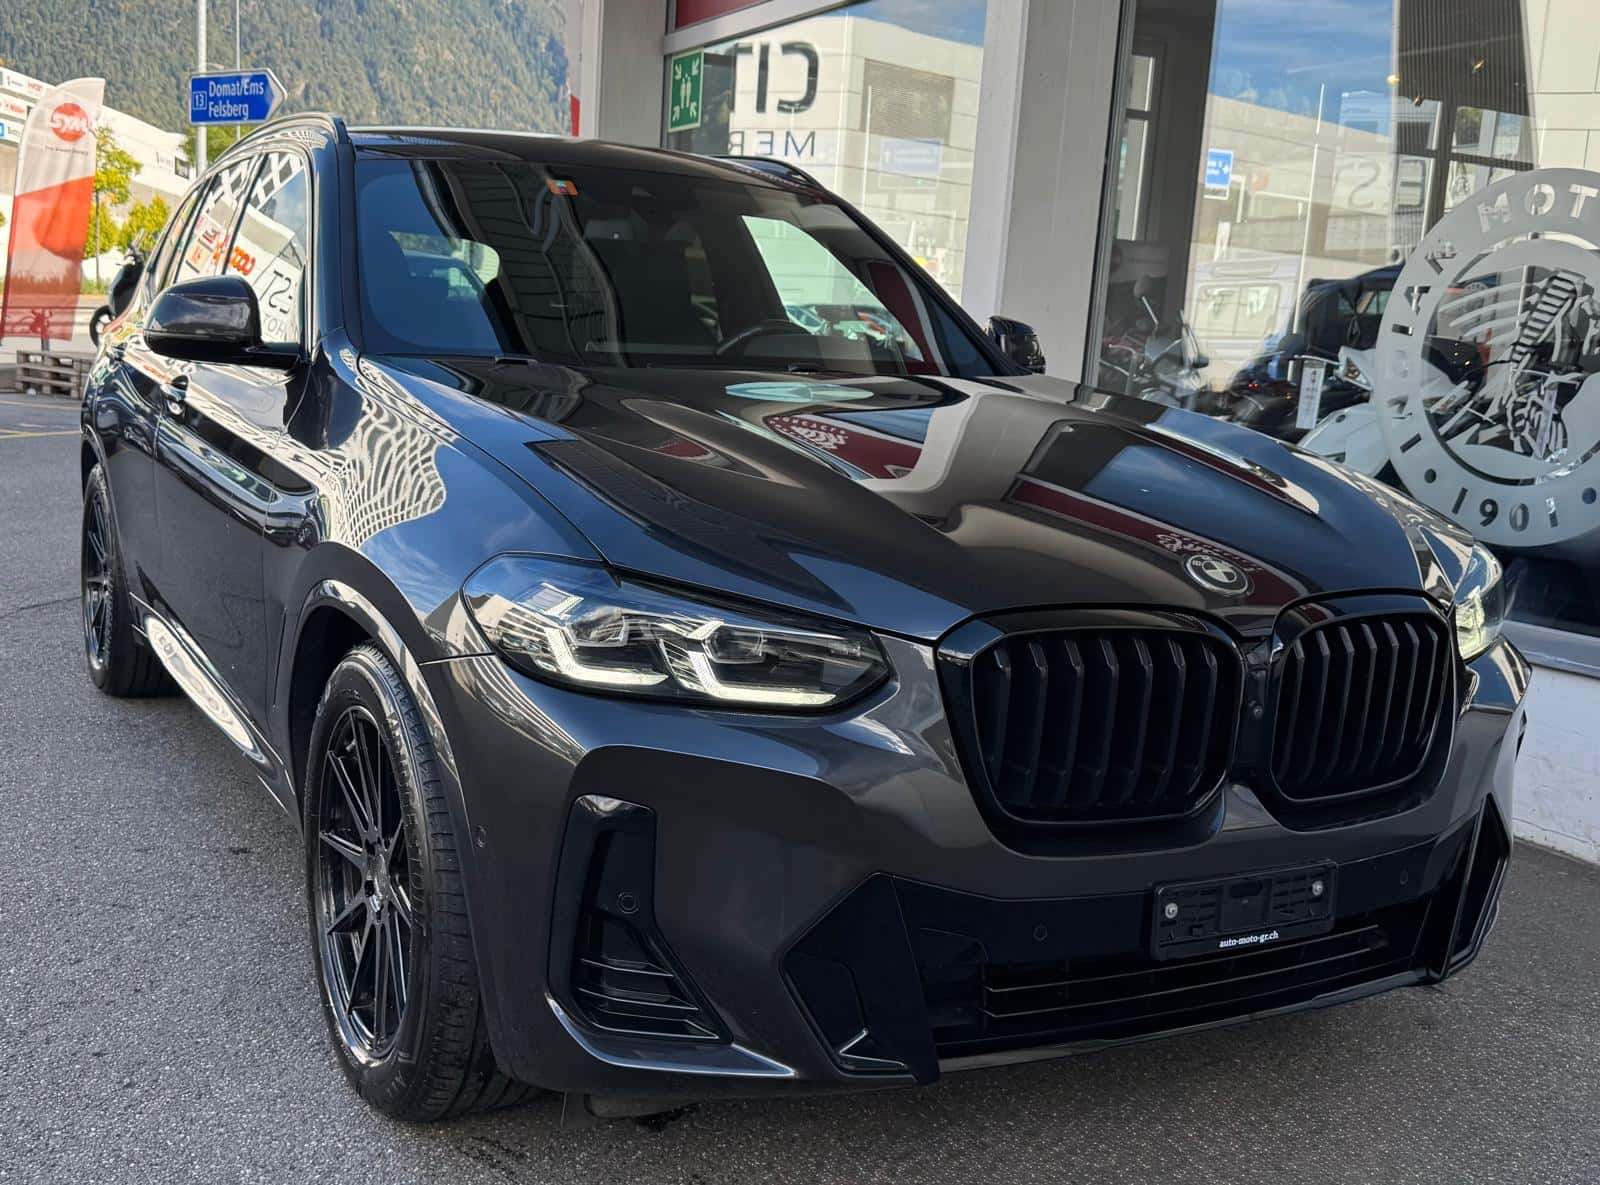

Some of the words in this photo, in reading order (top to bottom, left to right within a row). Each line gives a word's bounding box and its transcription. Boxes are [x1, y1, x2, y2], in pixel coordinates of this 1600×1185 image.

[208, 80, 264, 98] Domat/Ems
[195, 93, 204, 108] 13
[208, 100, 249, 121] Felsberg
[1451, 487, 1559, 532] 1901
[1219, 931, 1279, 948] auto-moto-gr.ch
